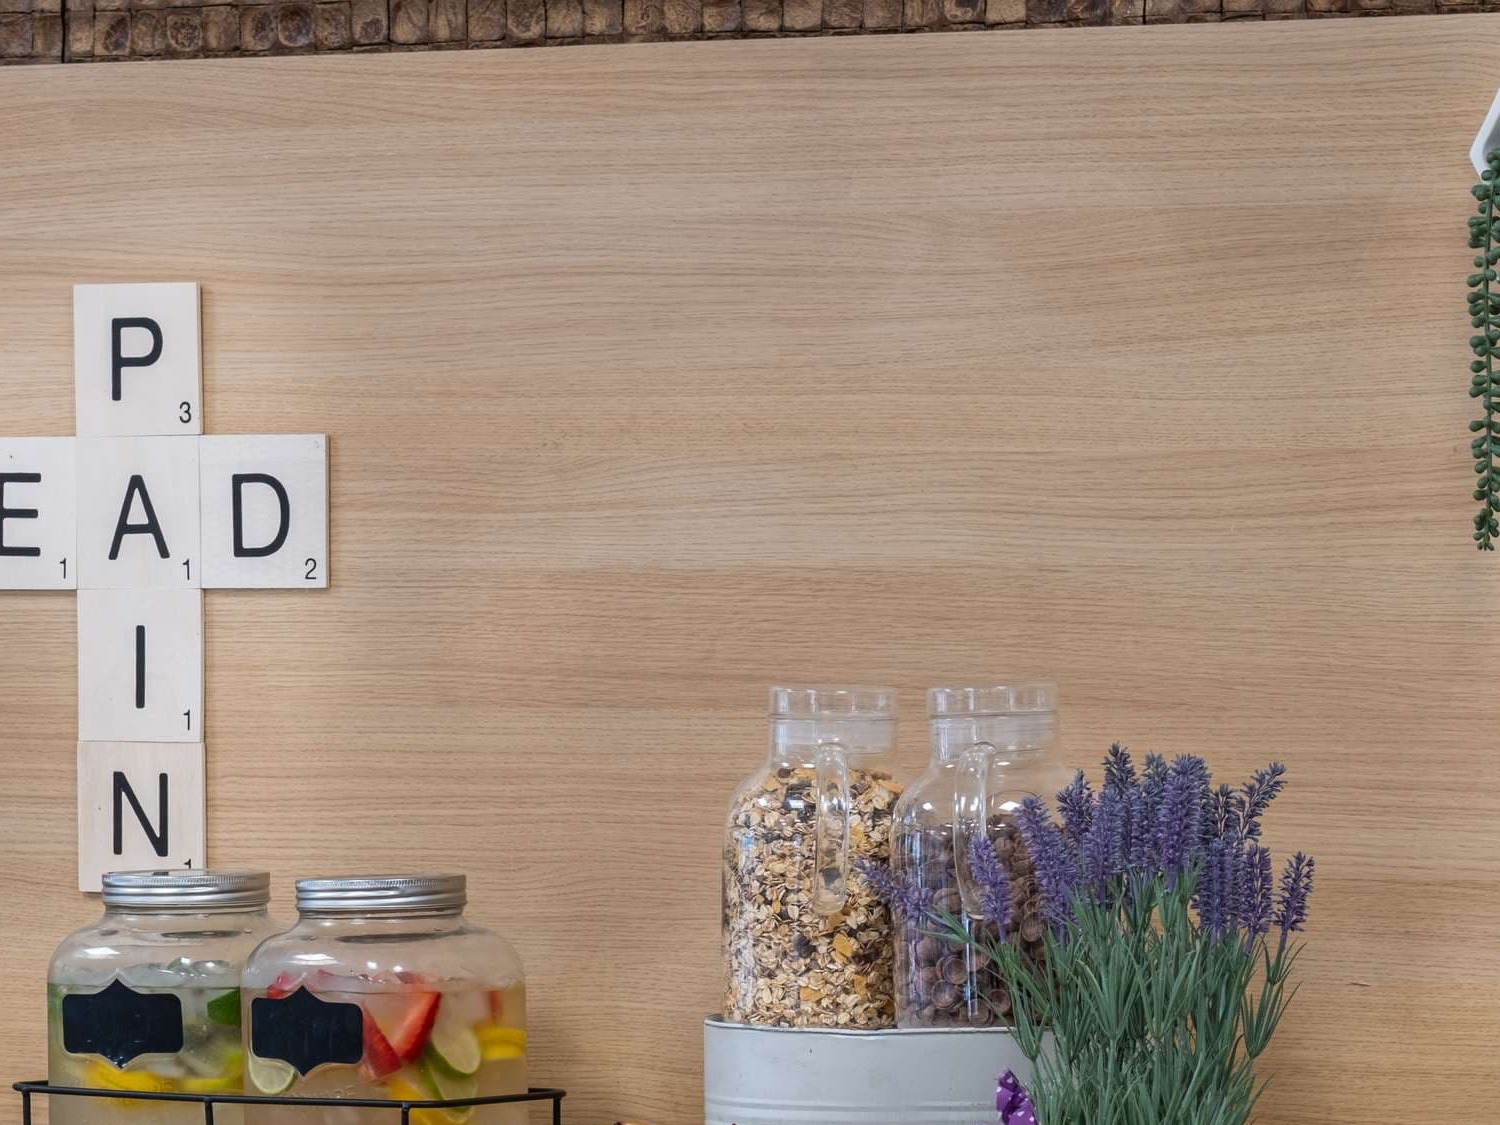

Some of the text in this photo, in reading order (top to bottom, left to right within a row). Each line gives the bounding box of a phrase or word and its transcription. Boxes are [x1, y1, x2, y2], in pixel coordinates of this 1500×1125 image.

[179, 401, 192, 424] 3
[58, 557, 67, 579] 1
[181, 559, 190, 580] 1
[304, 558, 318, 580] 2
[182, 710, 191, 731] 1
